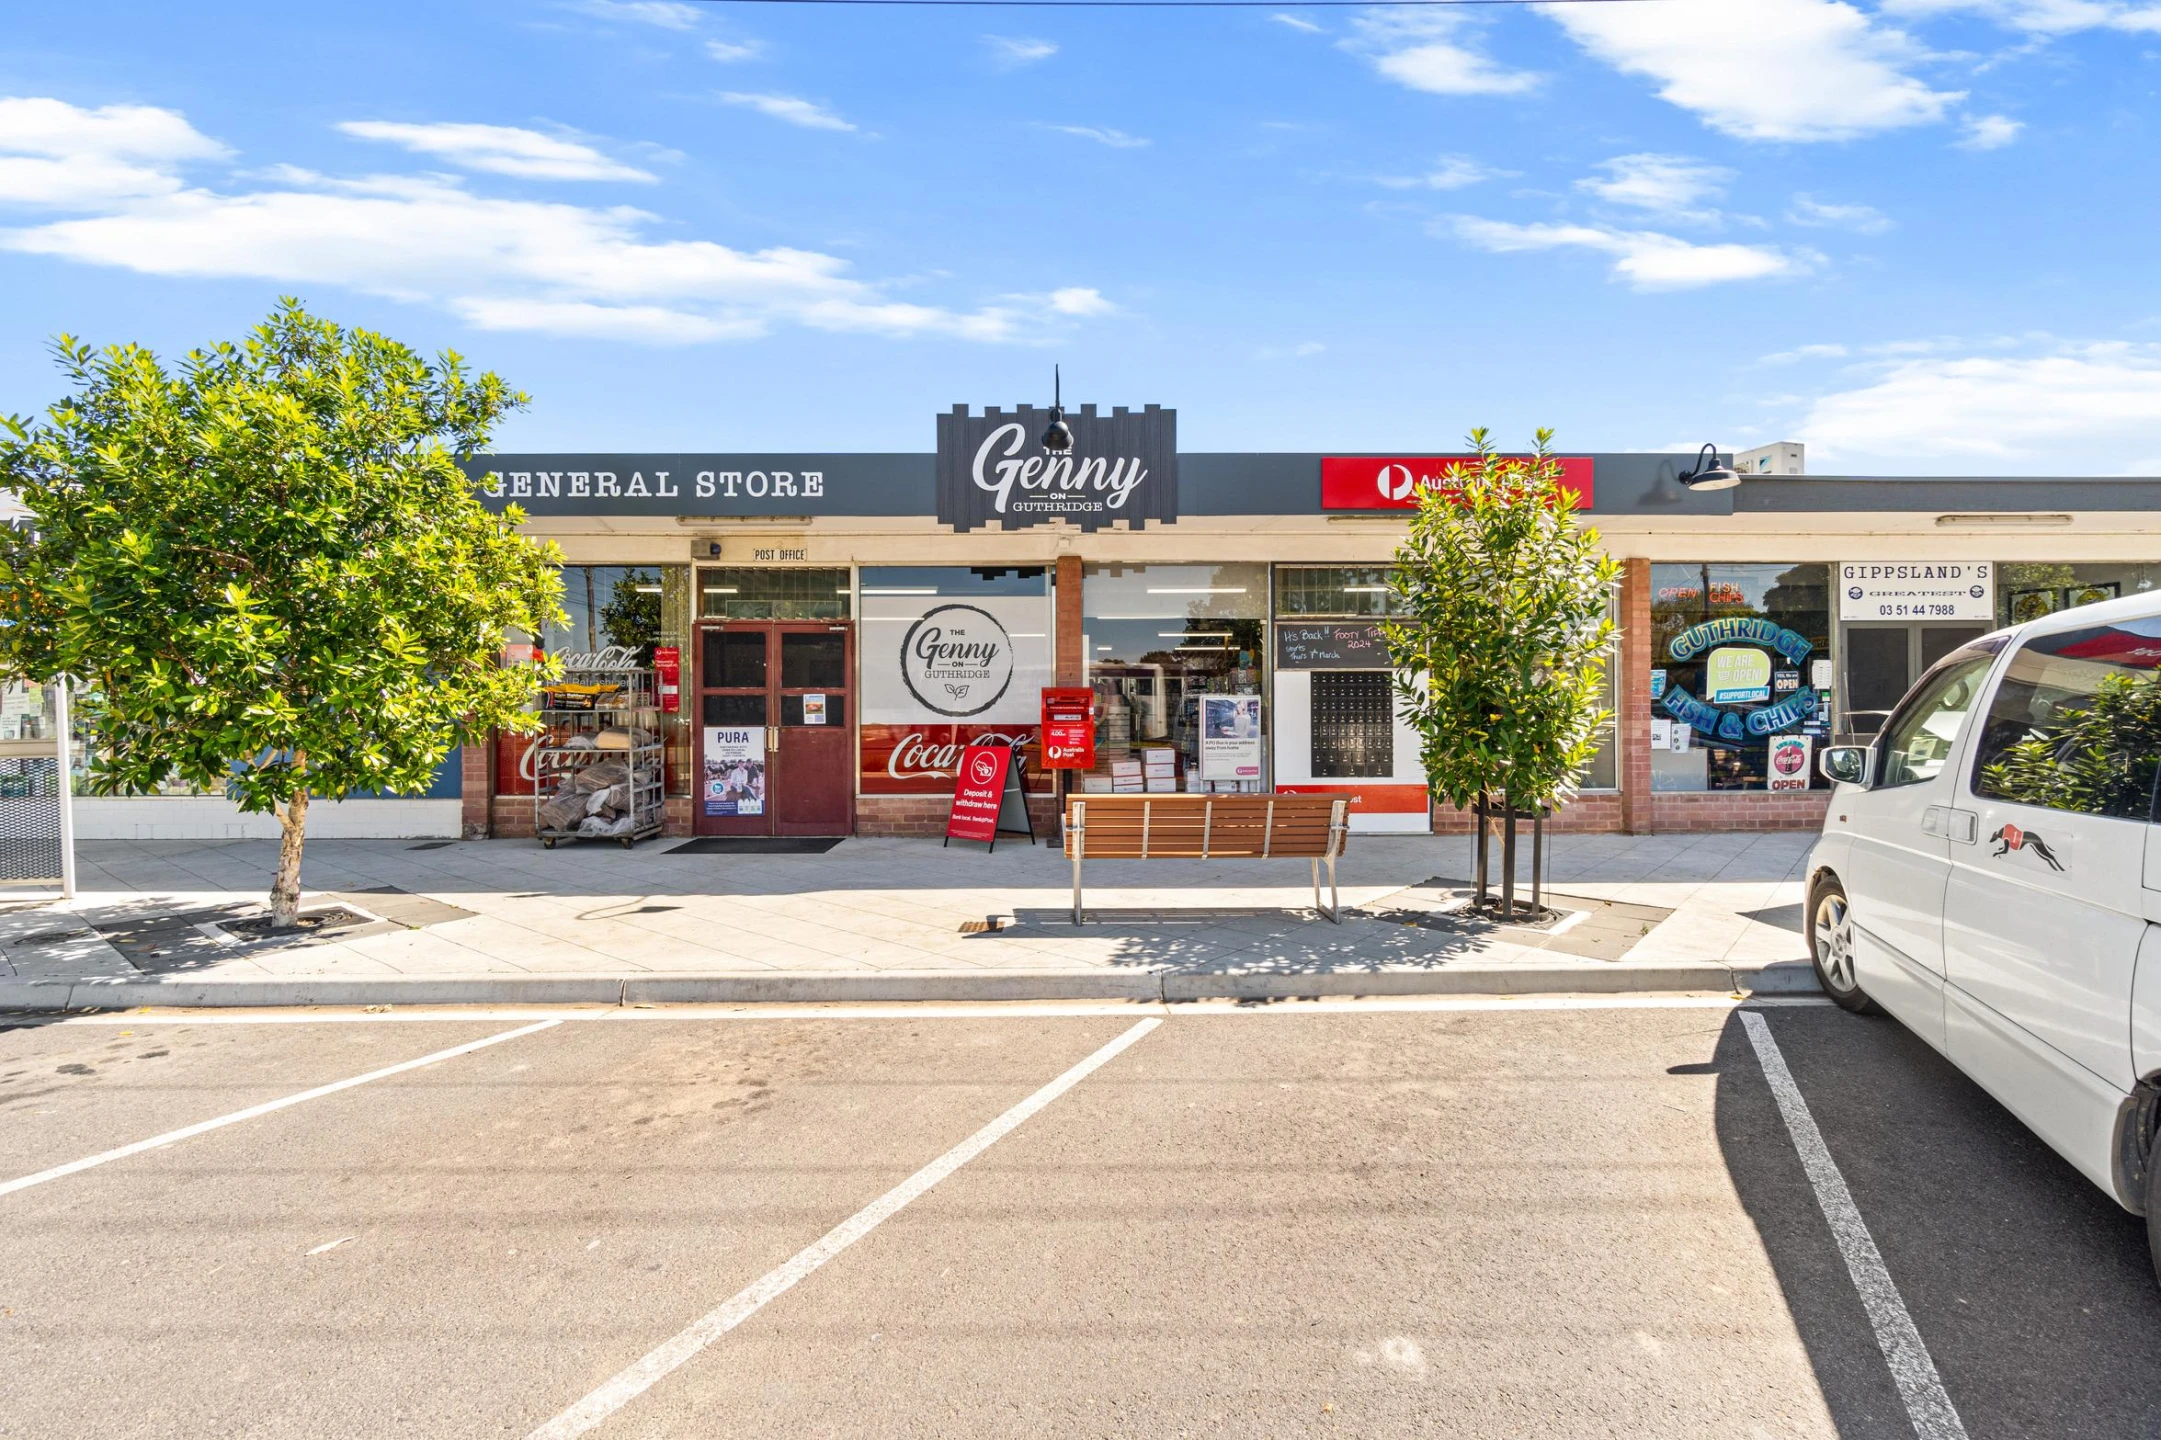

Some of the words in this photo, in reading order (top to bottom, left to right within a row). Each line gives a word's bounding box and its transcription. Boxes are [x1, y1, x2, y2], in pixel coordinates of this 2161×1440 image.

[972, 423, 1148, 513] Genny
[483, 471, 678, 498] GENERAL
[696, 471, 824, 498] STORE
[1013, 502, 1102, 512] GUTHRIDGE
[755, 549, 775, 560] POST
[780, 549, 804, 560] OFFICE
[1844, 566, 1988, 579] GIPPSLAND'S
[1710, 582, 1739, 592] FISH
[1658, 588, 1697, 599] OPEN
[1709, 592, 1744, 603] CHIPS
[1879, 605, 1893, 615] 03
[1896, 605, 1908, 615] 51
[1912, 605, 1925, 615] 44
[1929, 605, 1955, 615] 7988
[1300, 629, 1323, 640] Back
[1333, 628, 1359, 640] FOOTY
[1347, 641, 1371, 649] 2024
[1669, 617, 1813, 665] GUTHRIDGE
[915, 627, 1000, 669] Genny
[1717, 655, 1733, 669] WE
[1734, 654, 1754, 667] ARE
[924, 670, 990, 678] GUTHRIDGE
[1776, 679, 1798, 690] OPEN
[1662, 686, 1719, 734] FISH
[1719, 713, 1744, 739] &
[1747, 687, 1818, 735] CHIPS
[718, 731, 749, 743] PURA
[1772, 779, 1805, 790] OPEN
[964, 789, 987, 798] Deposit
[987, 790, 993, 799] &
[955, 799, 983, 808] withdraw
[983, 801, 998, 810] here
